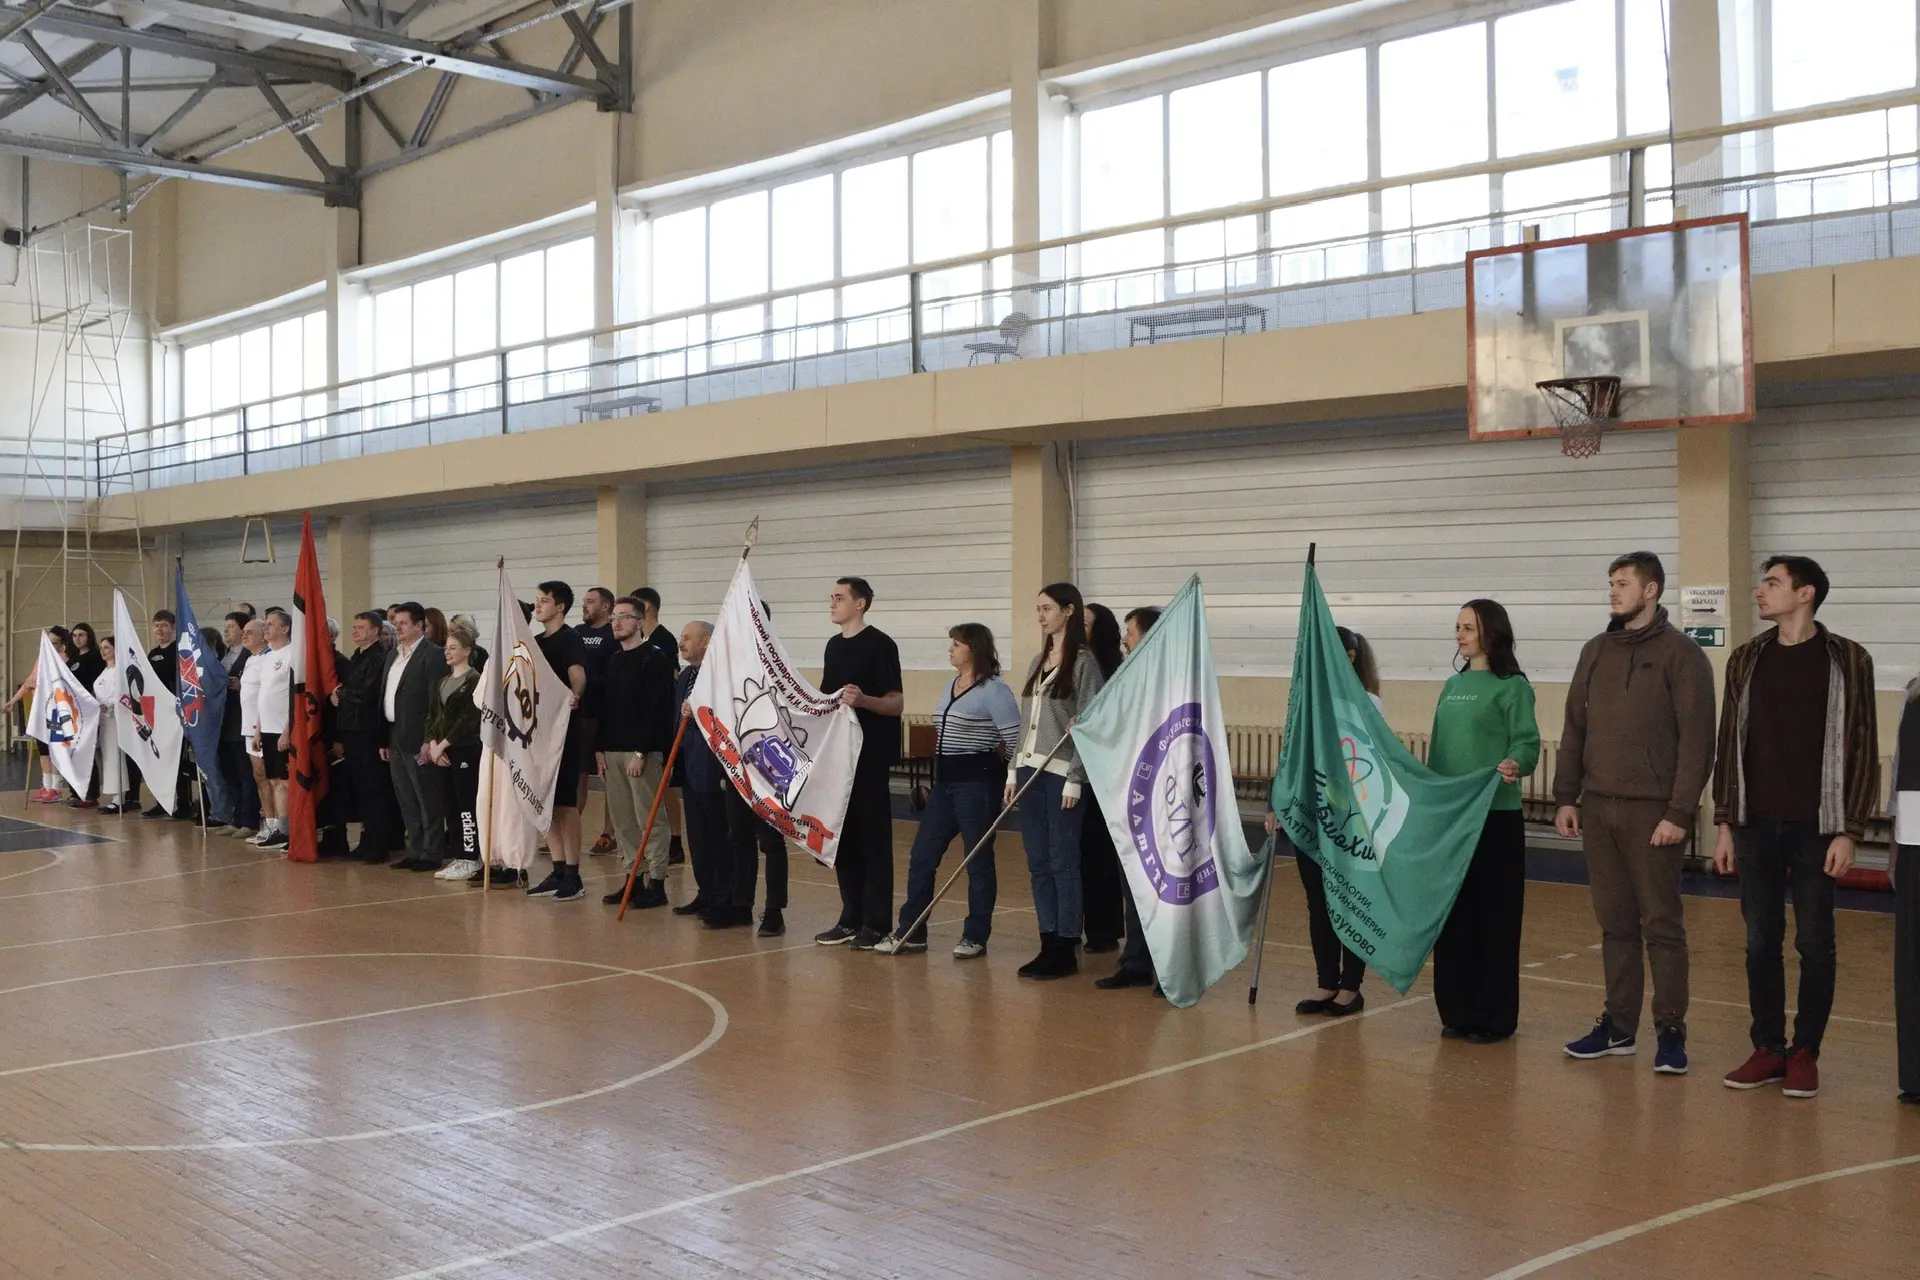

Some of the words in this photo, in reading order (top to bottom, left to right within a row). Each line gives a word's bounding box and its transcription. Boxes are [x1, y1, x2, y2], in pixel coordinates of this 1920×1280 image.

[775, 679, 786, 695] им.
[513, 769, 544, 815] факультет
[1338, 893, 1387, 940] ИНЖЕНЕРИИ
